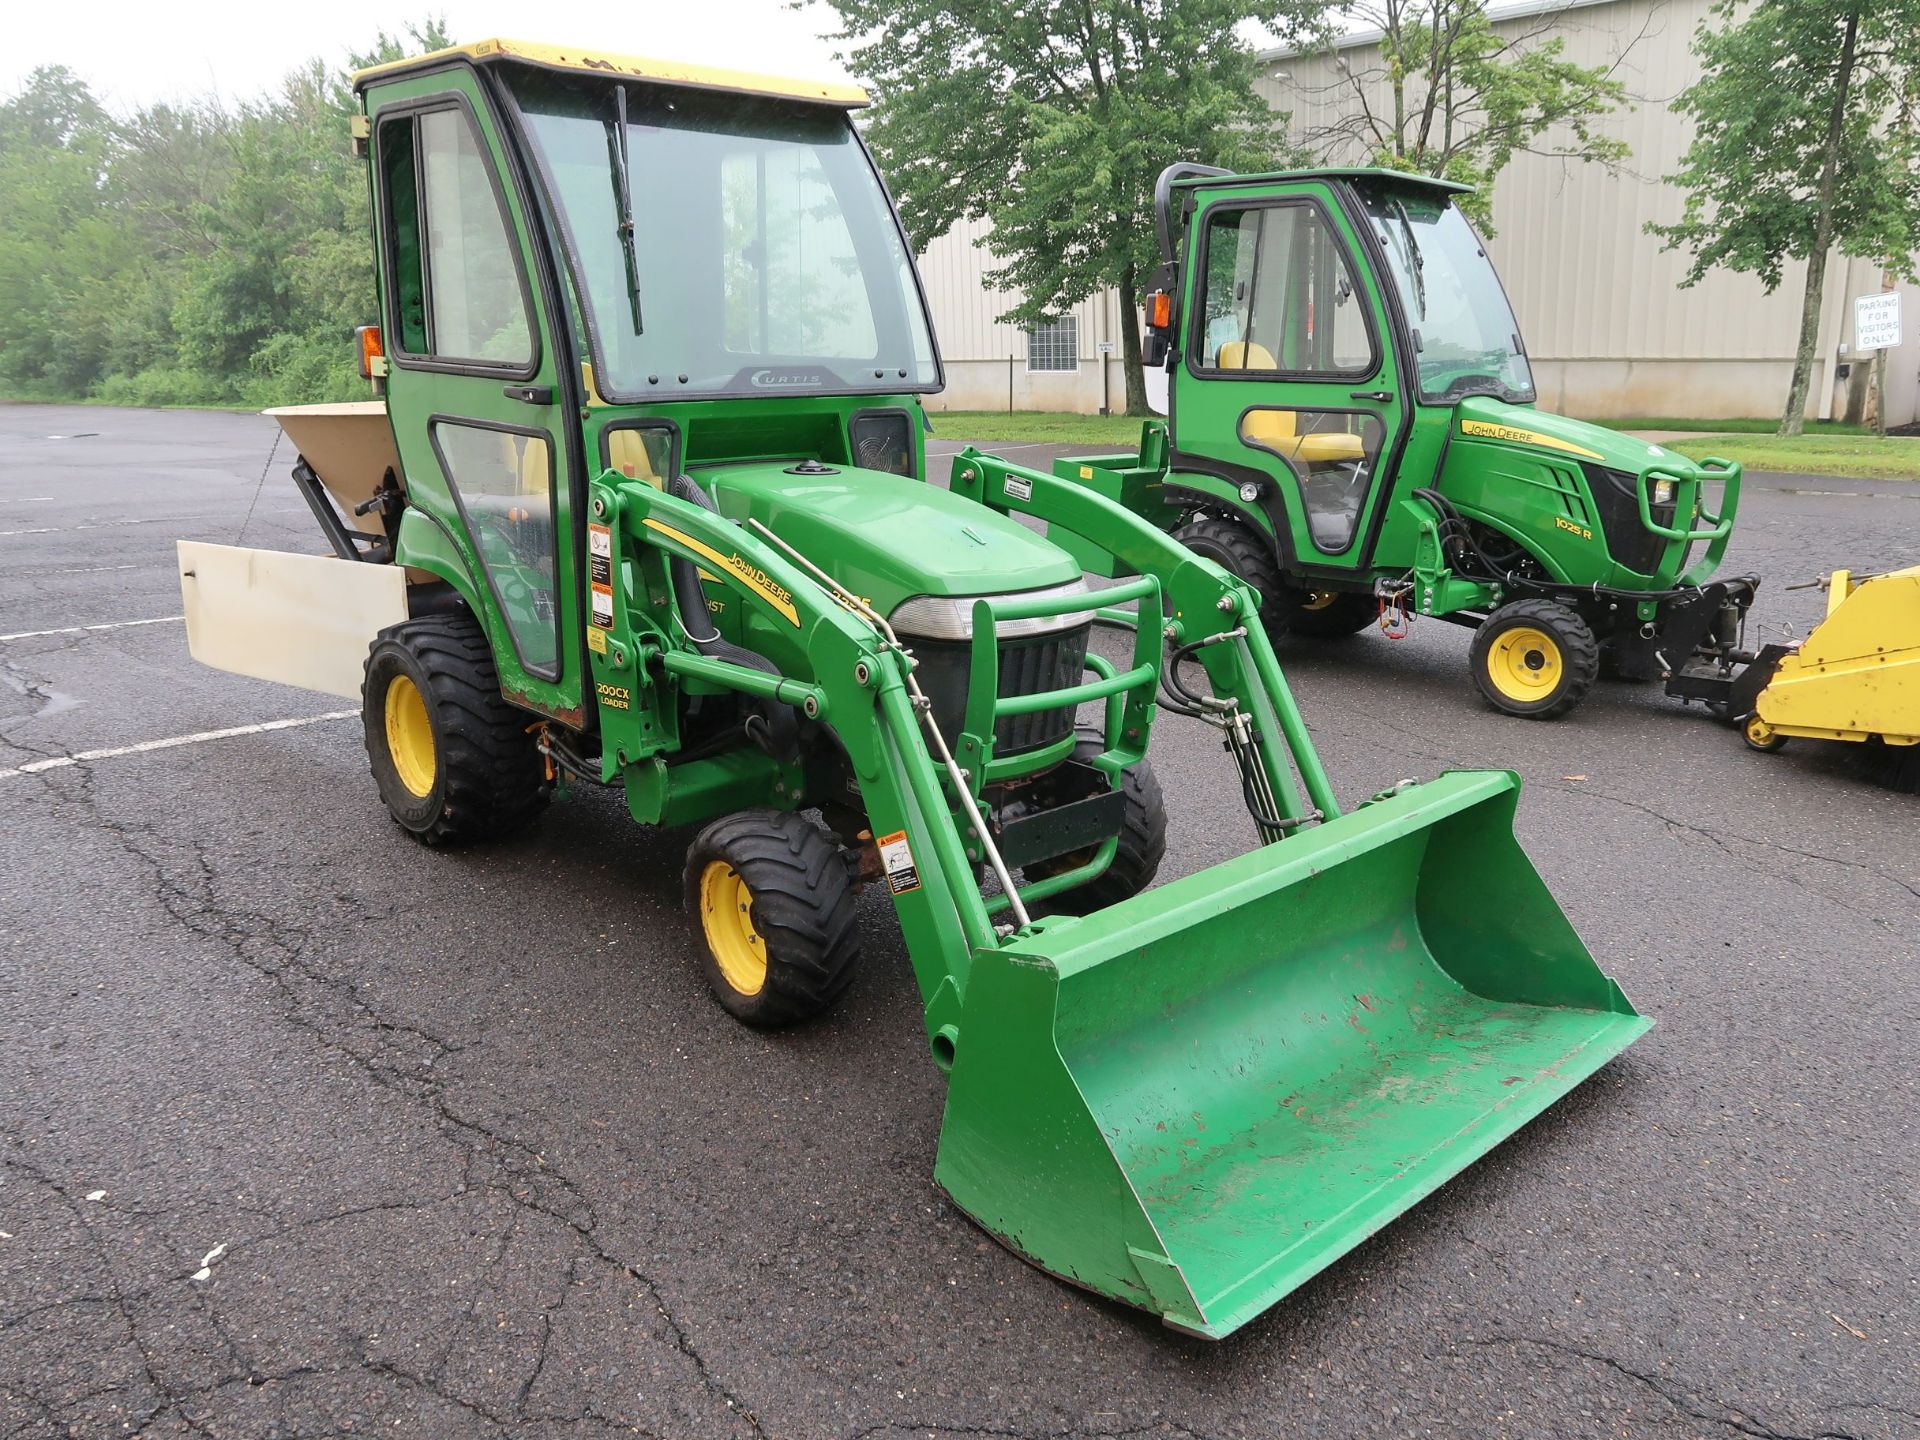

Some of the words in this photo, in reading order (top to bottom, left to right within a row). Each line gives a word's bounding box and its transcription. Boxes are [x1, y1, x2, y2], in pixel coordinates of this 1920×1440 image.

[1858, 299, 1897, 311] PARKING
[1868, 312, 1889, 321] FOR
[1857, 321, 1898, 333] VISITORS
[1863, 332, 1895, 344] ONLY
[751, 370, 822, 387] CURTIS
[1468, 424, 1496, 436] JOHN
[1498, 427, 1534, 441] DEERE
[728, 552, 756, 580] JOHN
[755, 569, 792, 605] DEERE
[597, 682, 630, 700] 200CX
[600, 696, 629, 710] LOADER
